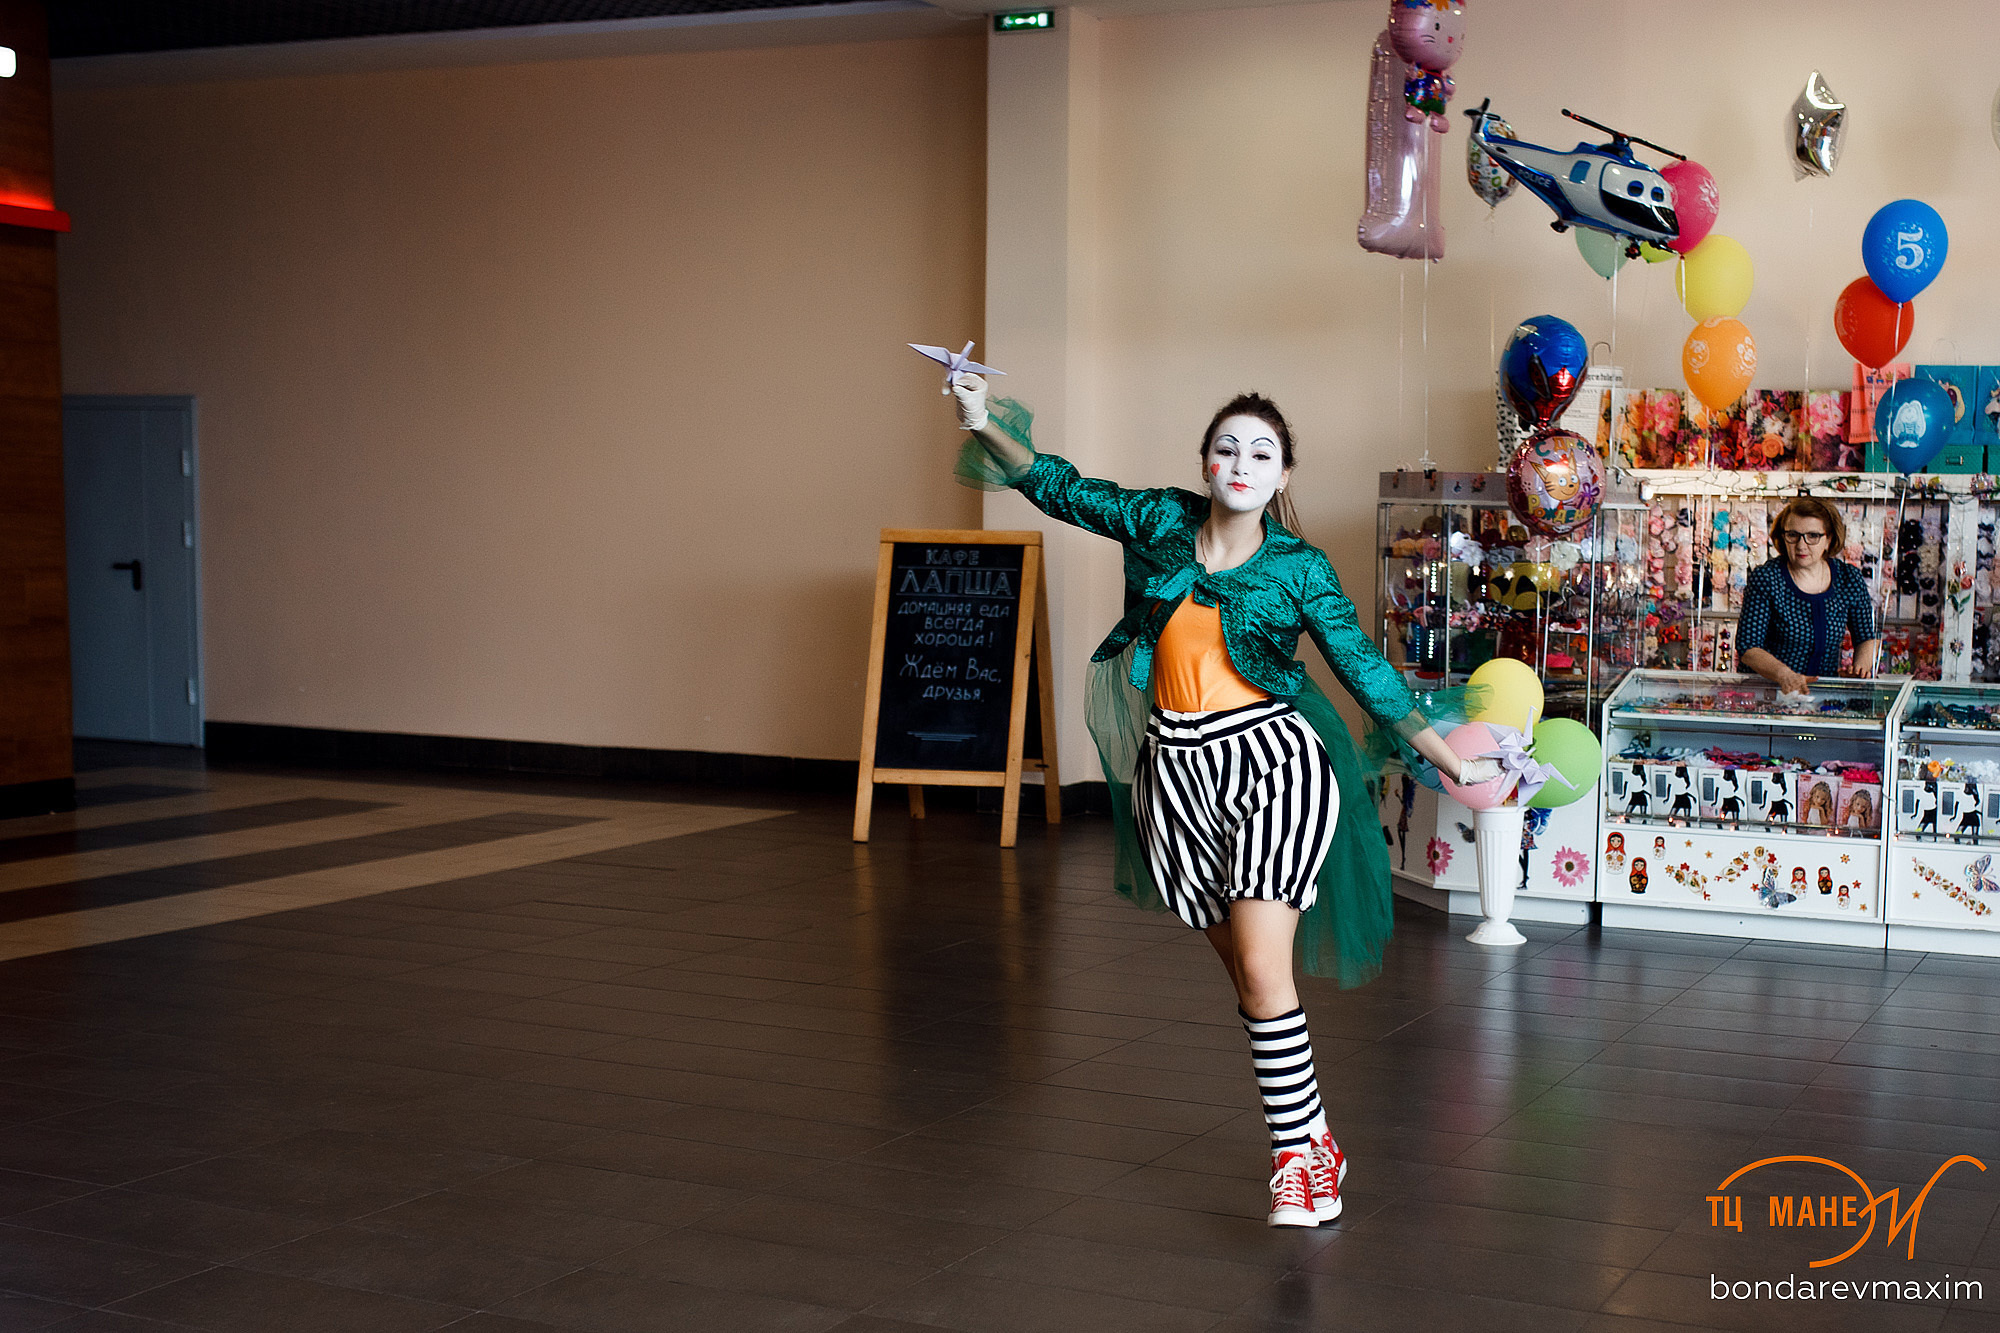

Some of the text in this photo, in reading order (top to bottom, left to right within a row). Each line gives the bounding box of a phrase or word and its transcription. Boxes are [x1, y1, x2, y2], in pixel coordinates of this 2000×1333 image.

[1517, 168, 1551, 188] POLICE
[1895, 226, 1924, 270] 5
[925, 549, 980, 566] КАФЕ
[900, 569, 1012, 596] ЛАПША
[899, 653, 957, 679] Ждём
